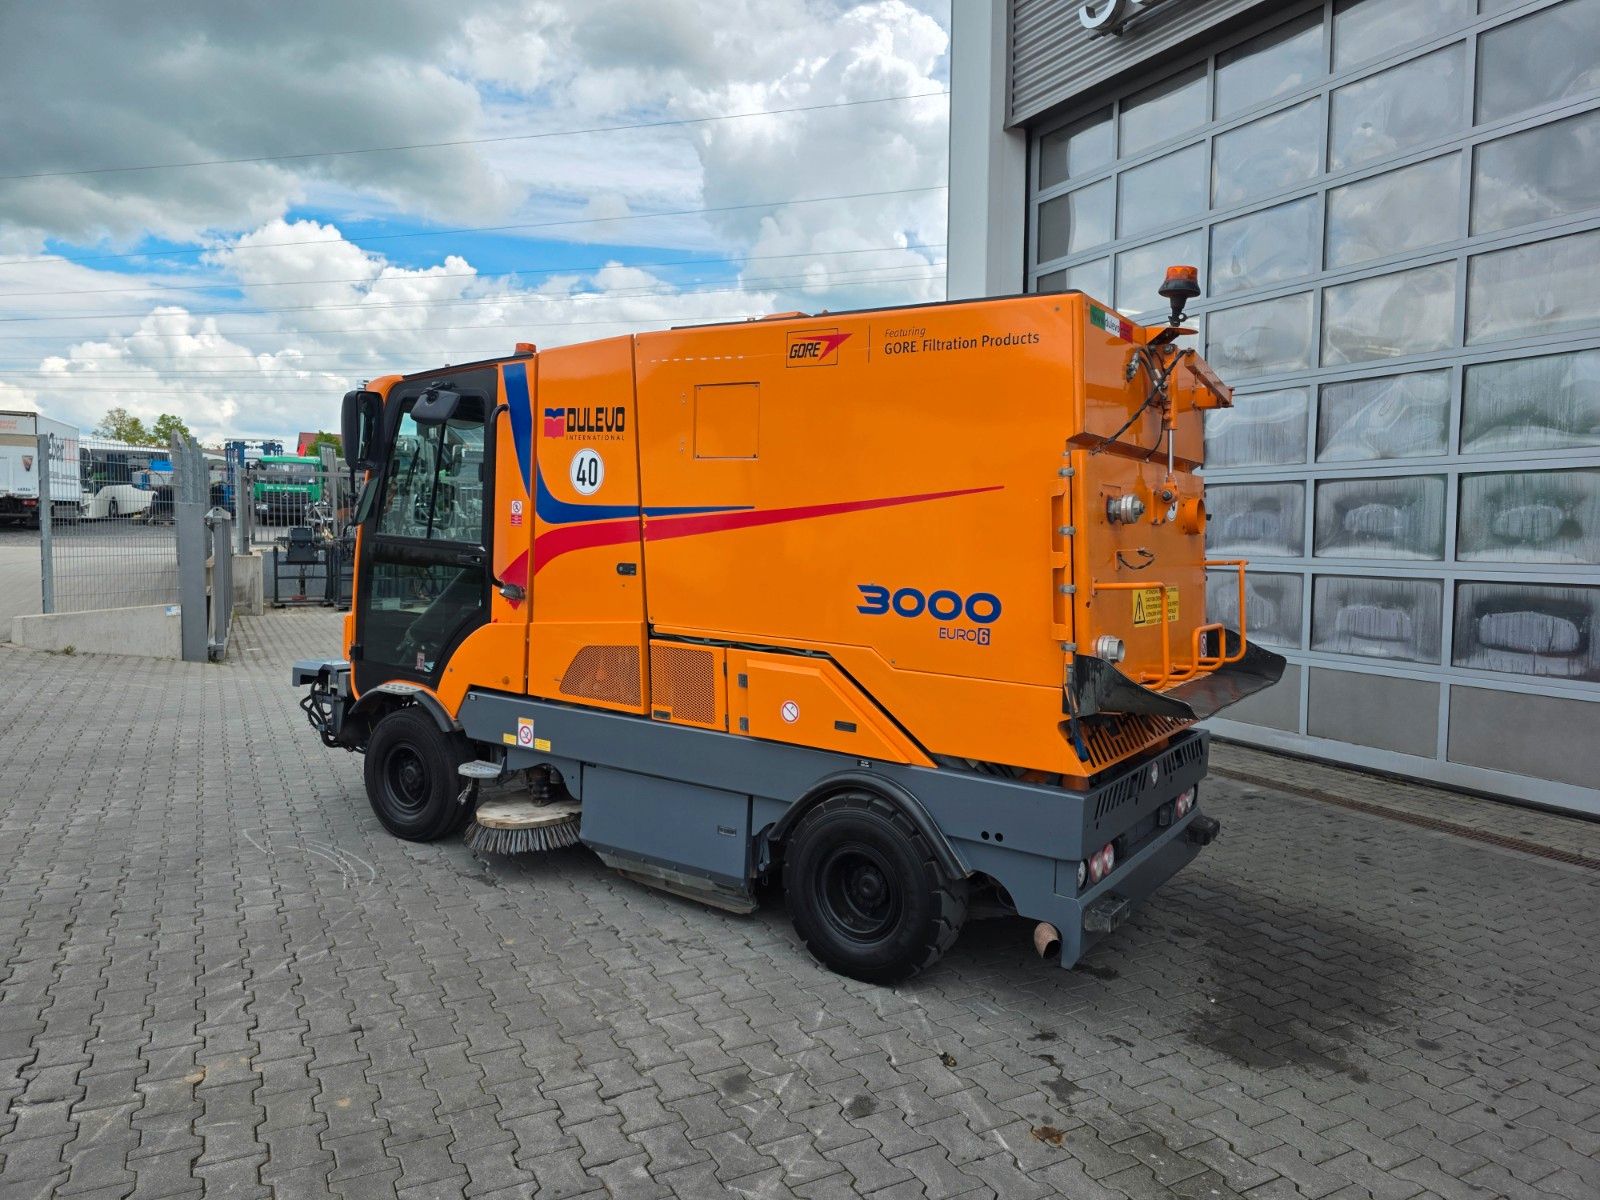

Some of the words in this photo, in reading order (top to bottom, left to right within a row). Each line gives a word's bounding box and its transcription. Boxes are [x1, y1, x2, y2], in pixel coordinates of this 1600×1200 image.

[884, 341, 917, 355] GORE
[922, 336, 977, 352] Filtration
[981, 332, 1040, 347] Products
[885, 325, 927, 338] Featuring
[789, 342, 821, 359] GORE
[566, 407, 625, 432] DULEVO
[576, 457, 598, 487] 40
[856, 584, 1002, 624] 3000
